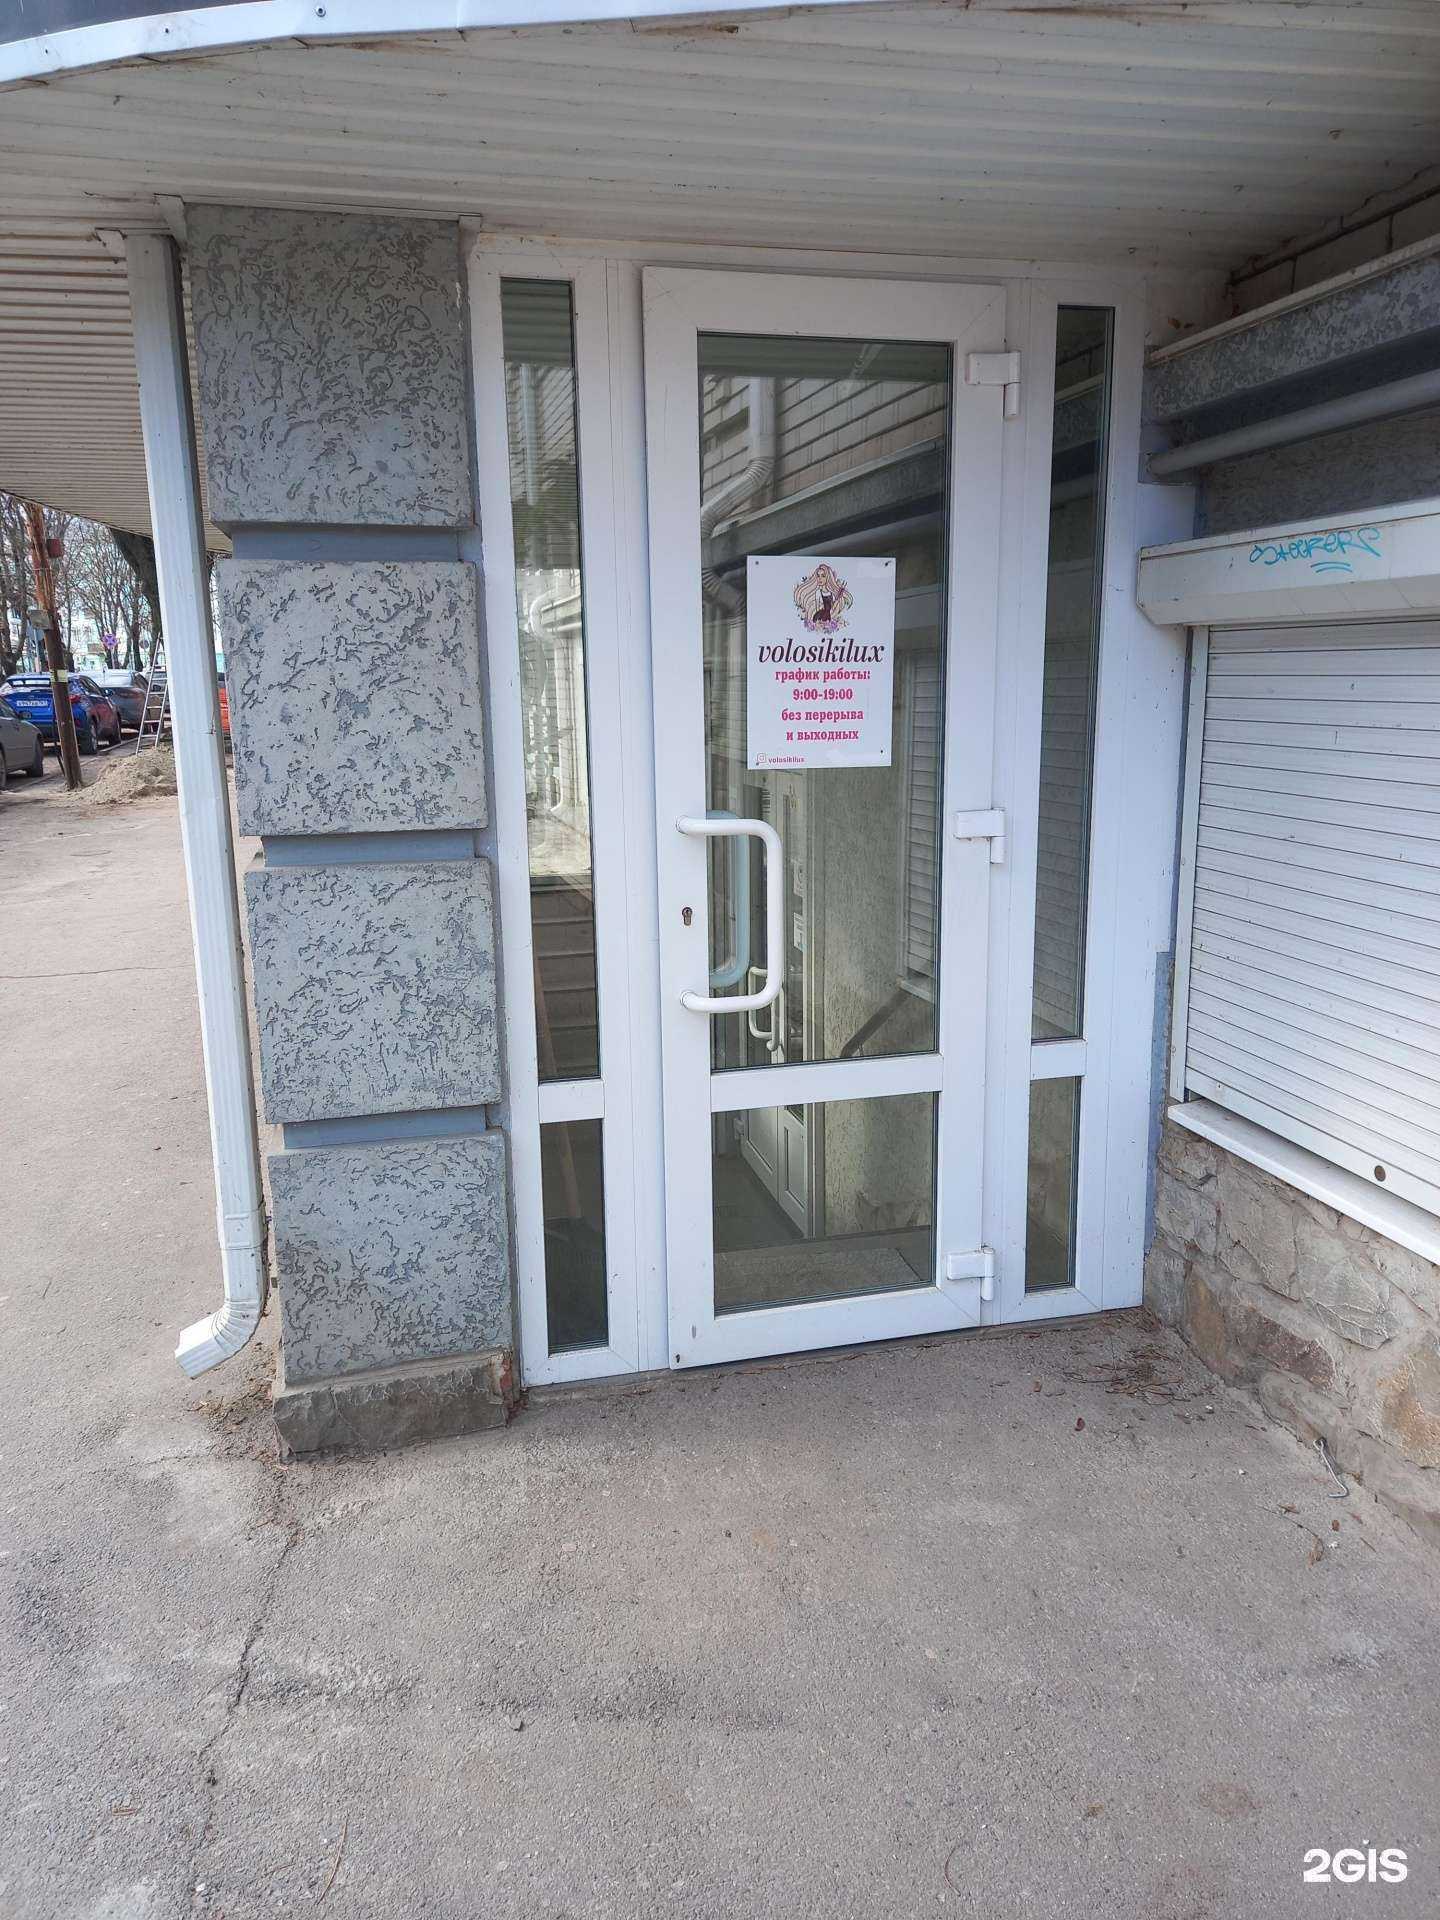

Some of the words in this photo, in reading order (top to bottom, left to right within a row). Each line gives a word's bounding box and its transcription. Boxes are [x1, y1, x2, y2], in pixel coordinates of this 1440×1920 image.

[758, 638, 885, 663] volosikilux
[775, 668, 820, 683] график
[823, 667, 871, 683] работы:
[792, 688, 853, 701] 9:00-19:00
[781, 708, 802, 721] без
[805, 709, 864, 724] перерыва
[786, 732, 793, 741] и
[797, 731, 859, 742] выходных
